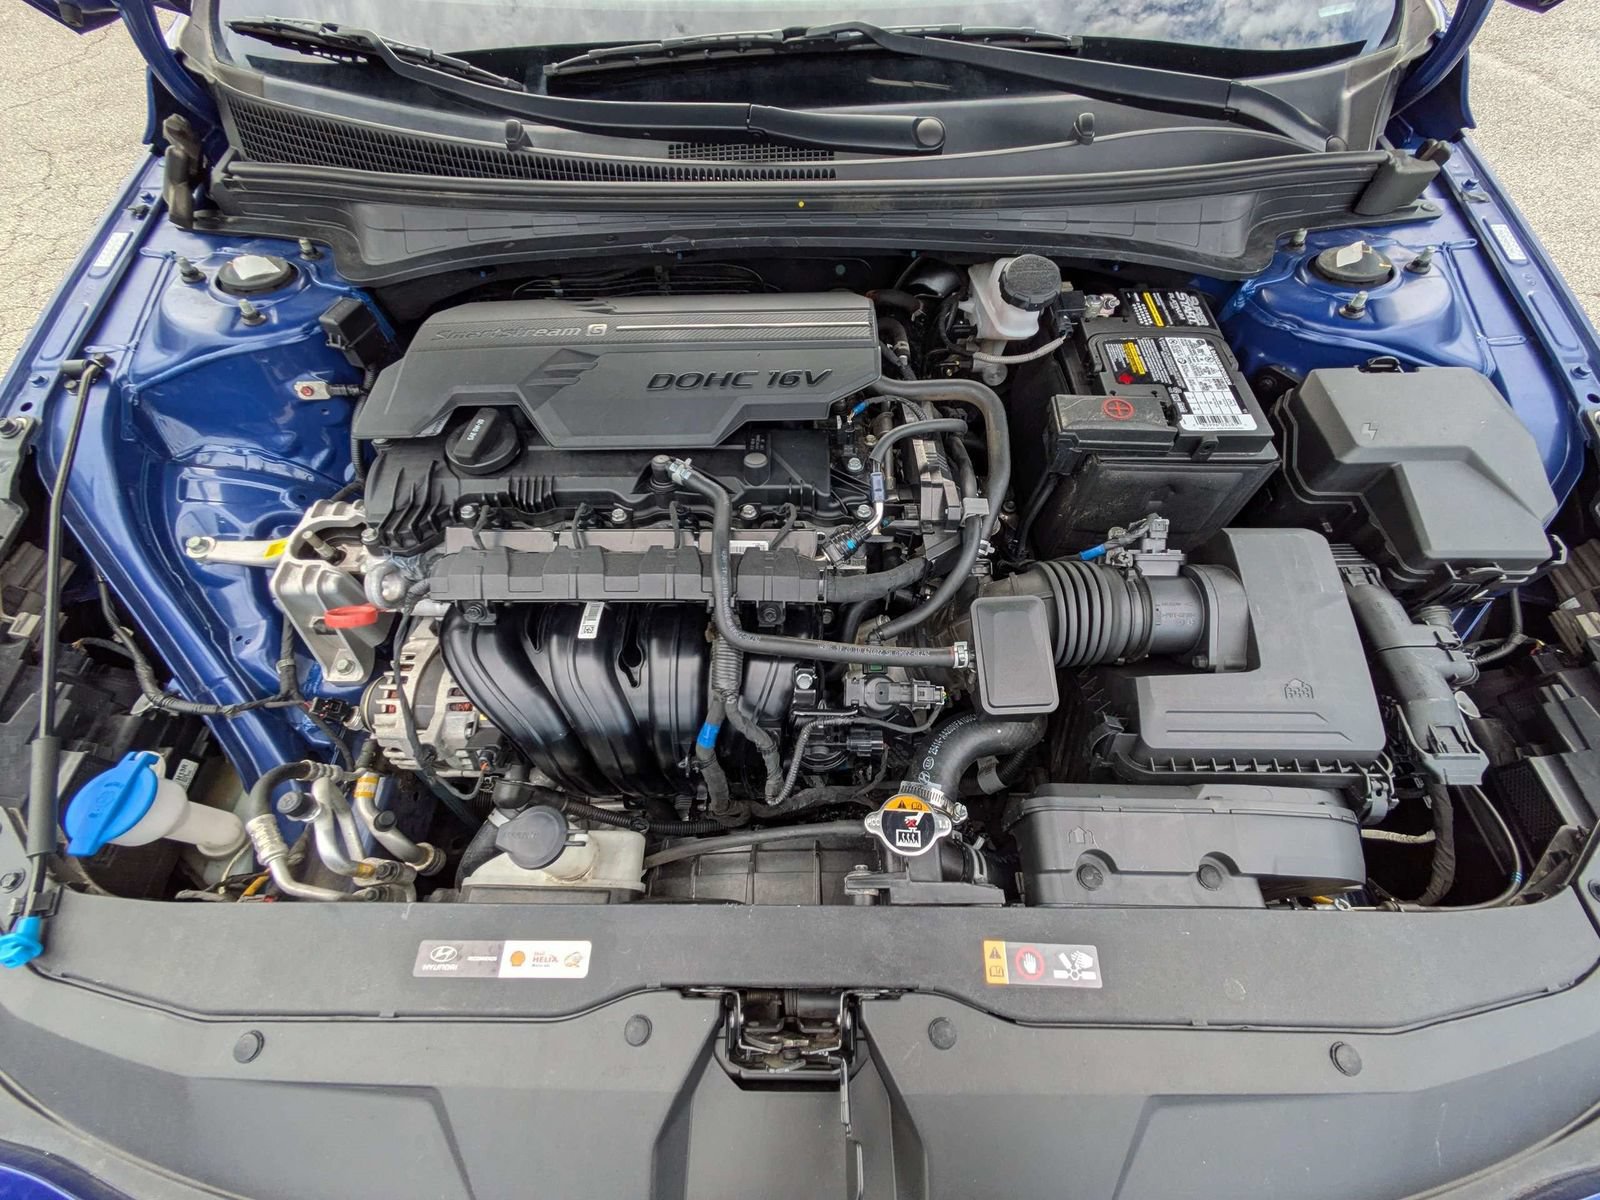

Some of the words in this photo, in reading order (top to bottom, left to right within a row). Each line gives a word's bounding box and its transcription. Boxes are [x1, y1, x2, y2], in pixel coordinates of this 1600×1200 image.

[431, 326, 582, 341] Smartstream
[647, 370, 759, 391] DOHC
[767, 368, 833, 389] 16V
[532, 955, 559, 963] HELIX
[422, 963, 458, 972] HYUNDAI
